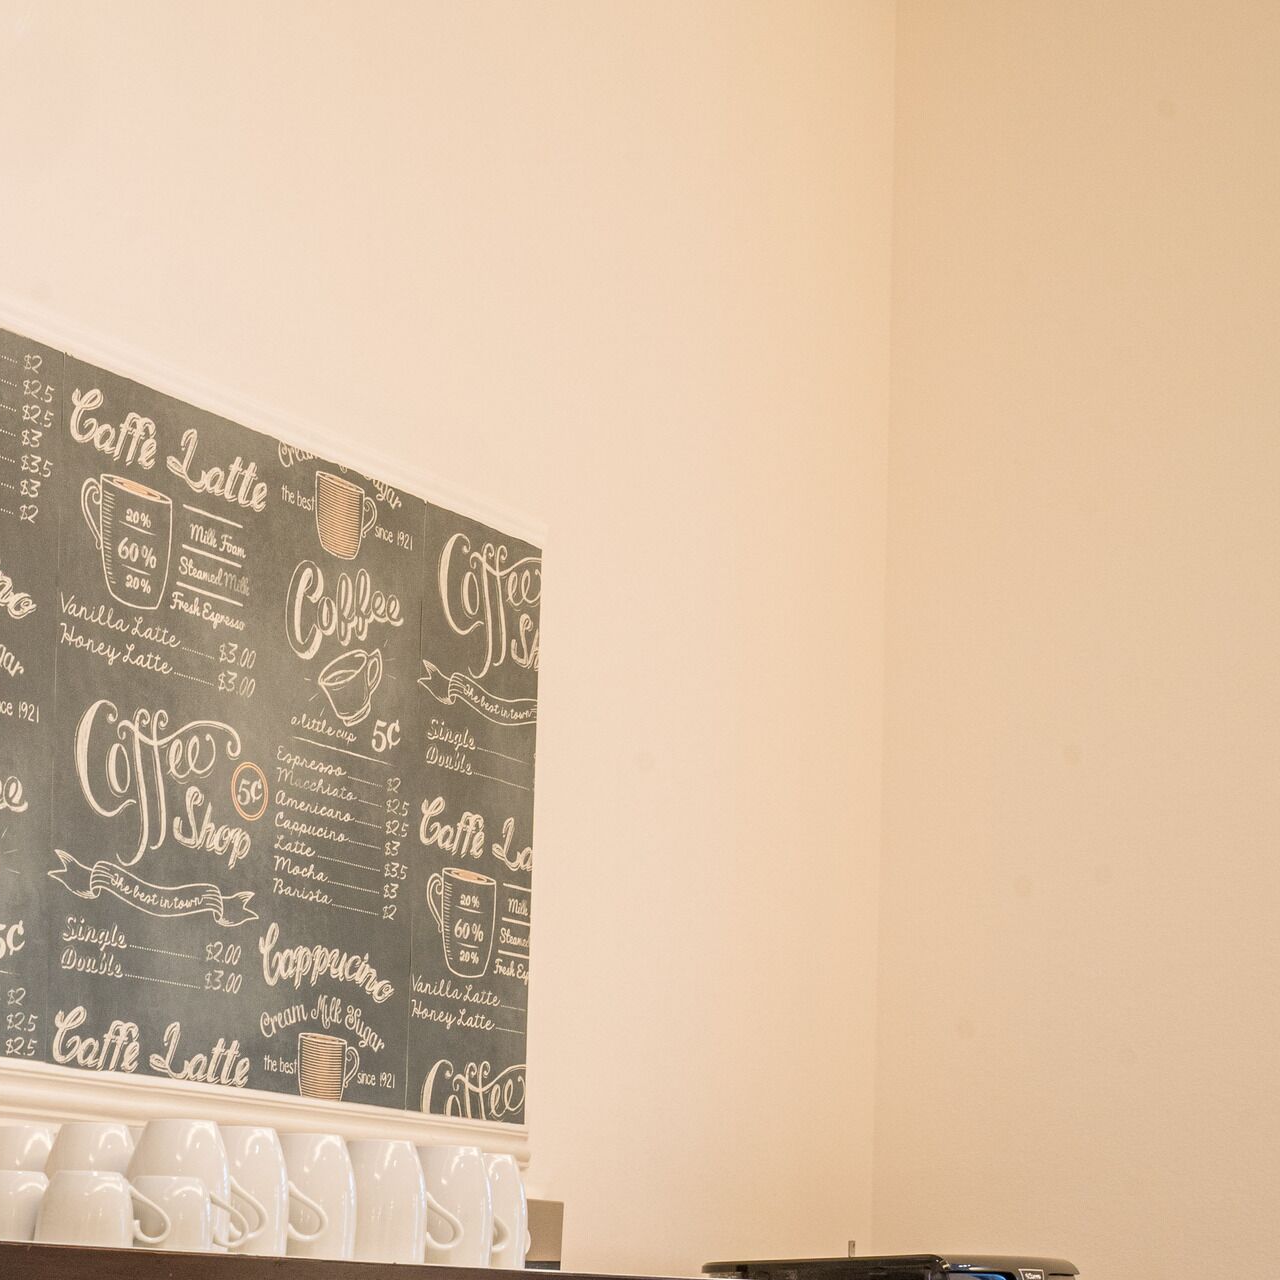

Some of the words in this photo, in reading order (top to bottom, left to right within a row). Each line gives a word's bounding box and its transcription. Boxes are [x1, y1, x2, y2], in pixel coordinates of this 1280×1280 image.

[22, 354, 44, 375] $2
[22, 379, 56, 404] $2.5
[21, 404, 55, 429] $2.5
[190, 523, 218, 549] Milk
[220, 535, 247, 560] Foam
[285, 559, 405, 660] Coffee
[59, 622, 121, 666] Honey
[122, 642, 174, 675] Latte
[217, 671, 257, 699] $3.00
[74, 699, 241, 867] Coffee
[172, 785, 252, 870] Shop
[272, 877, 333, 906] Barista
[382, 904, 398, 921] $2
[273, 855, 329, 884] Mocha
[383, 881, 400, 899] $3
[259, 922, 395, 1004] Cappucino
[411, 974, 462, 1001] Vanilla
[462, 985, 501, 1008] Latte
[149, 1021, 251, 1089] Latte
[356, 1068, 377, 1088] since
[379, 1072, 395, 1090] 1921
